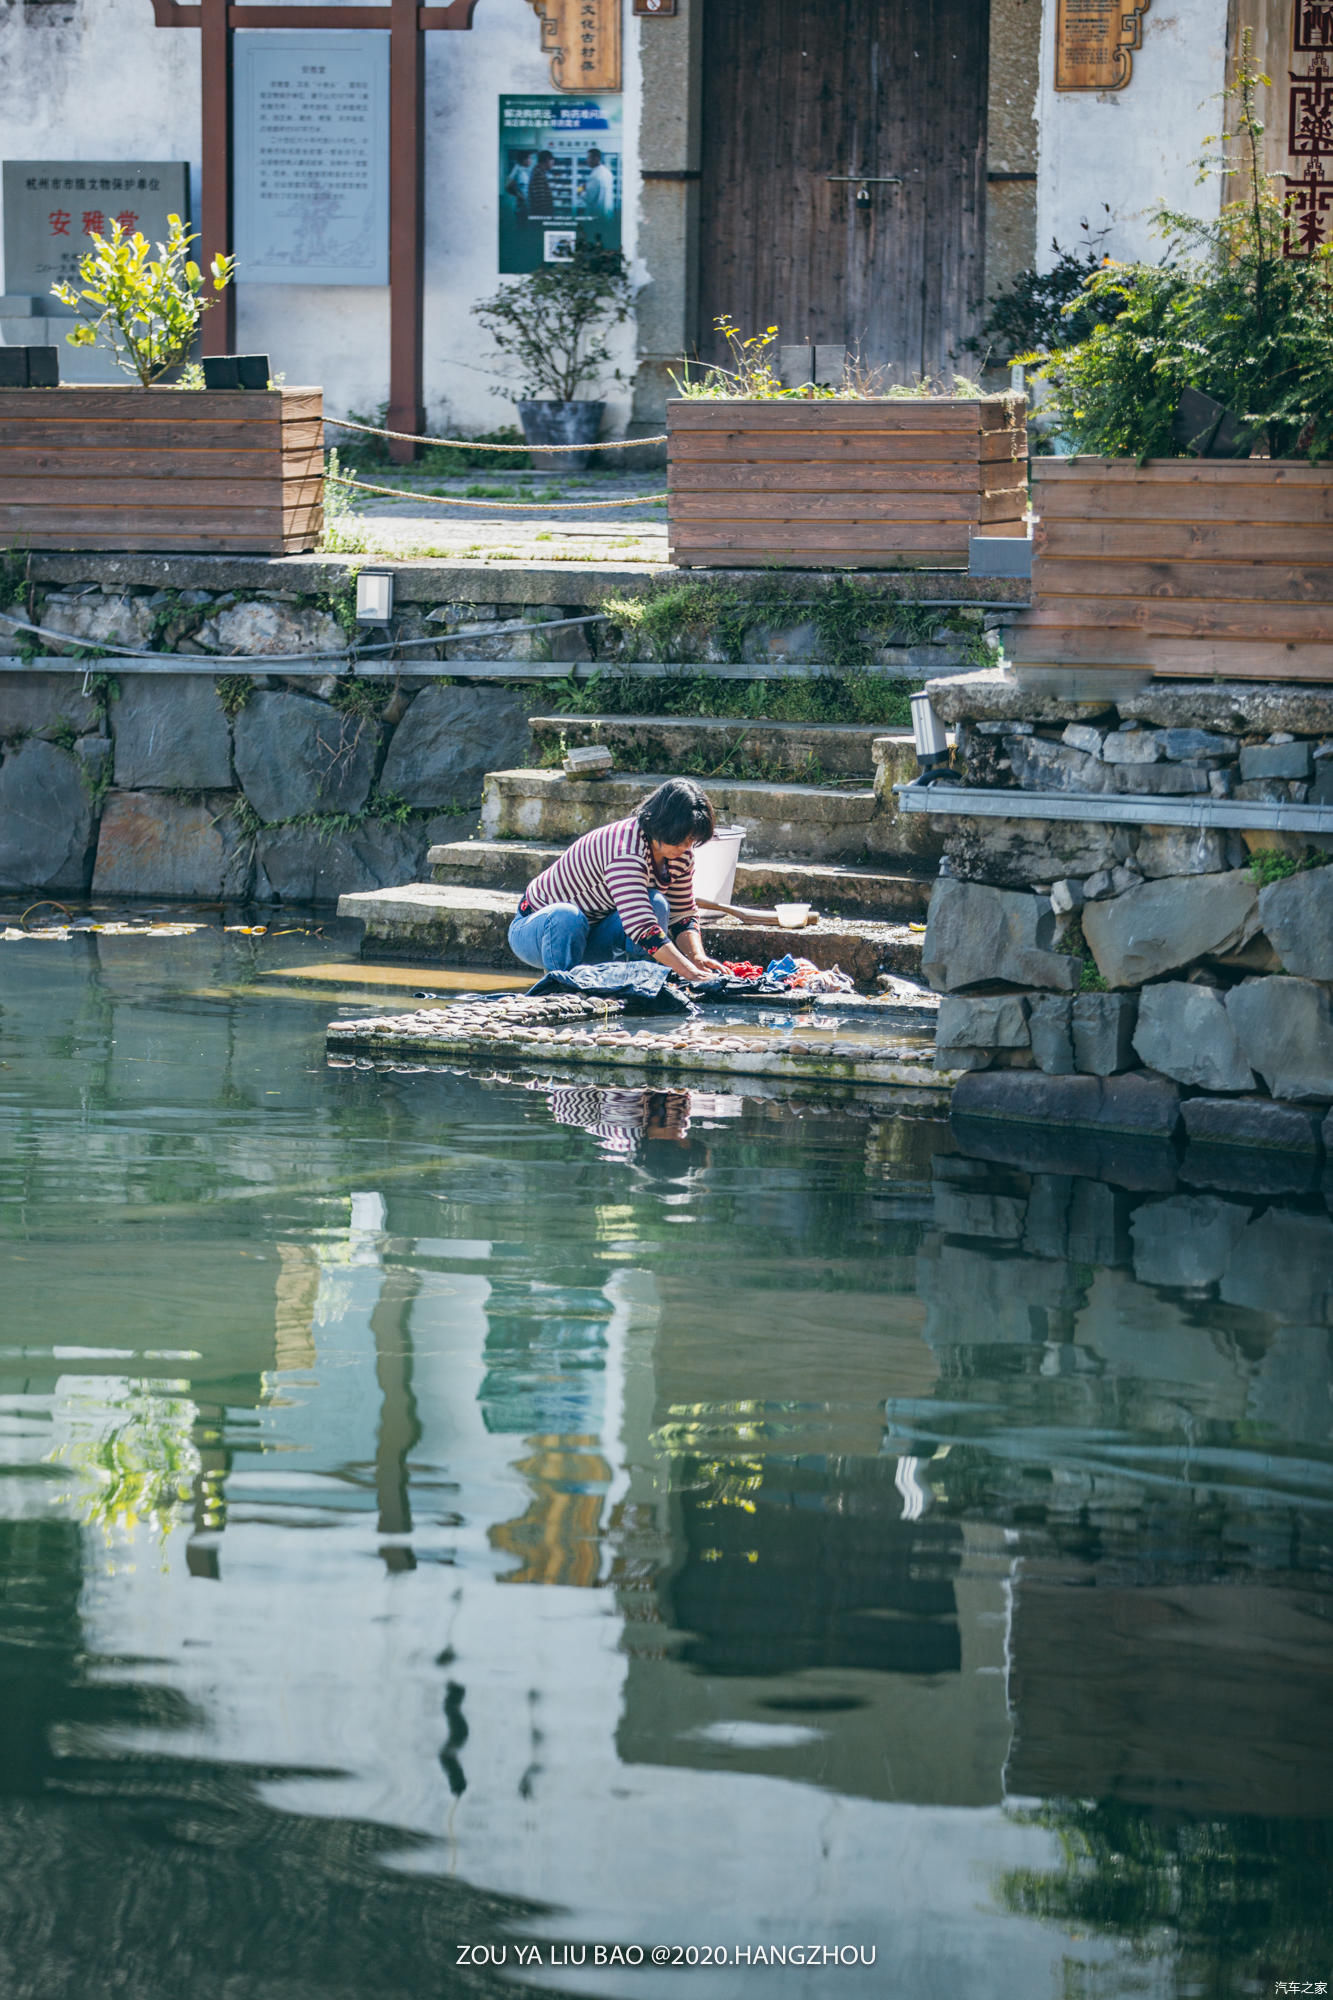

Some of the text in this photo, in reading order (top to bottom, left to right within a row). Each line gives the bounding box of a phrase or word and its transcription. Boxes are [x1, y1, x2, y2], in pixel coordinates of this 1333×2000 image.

[581, 0, 595, 71] 文化古村落
[48, 209, 139, 236] 安雅堂
